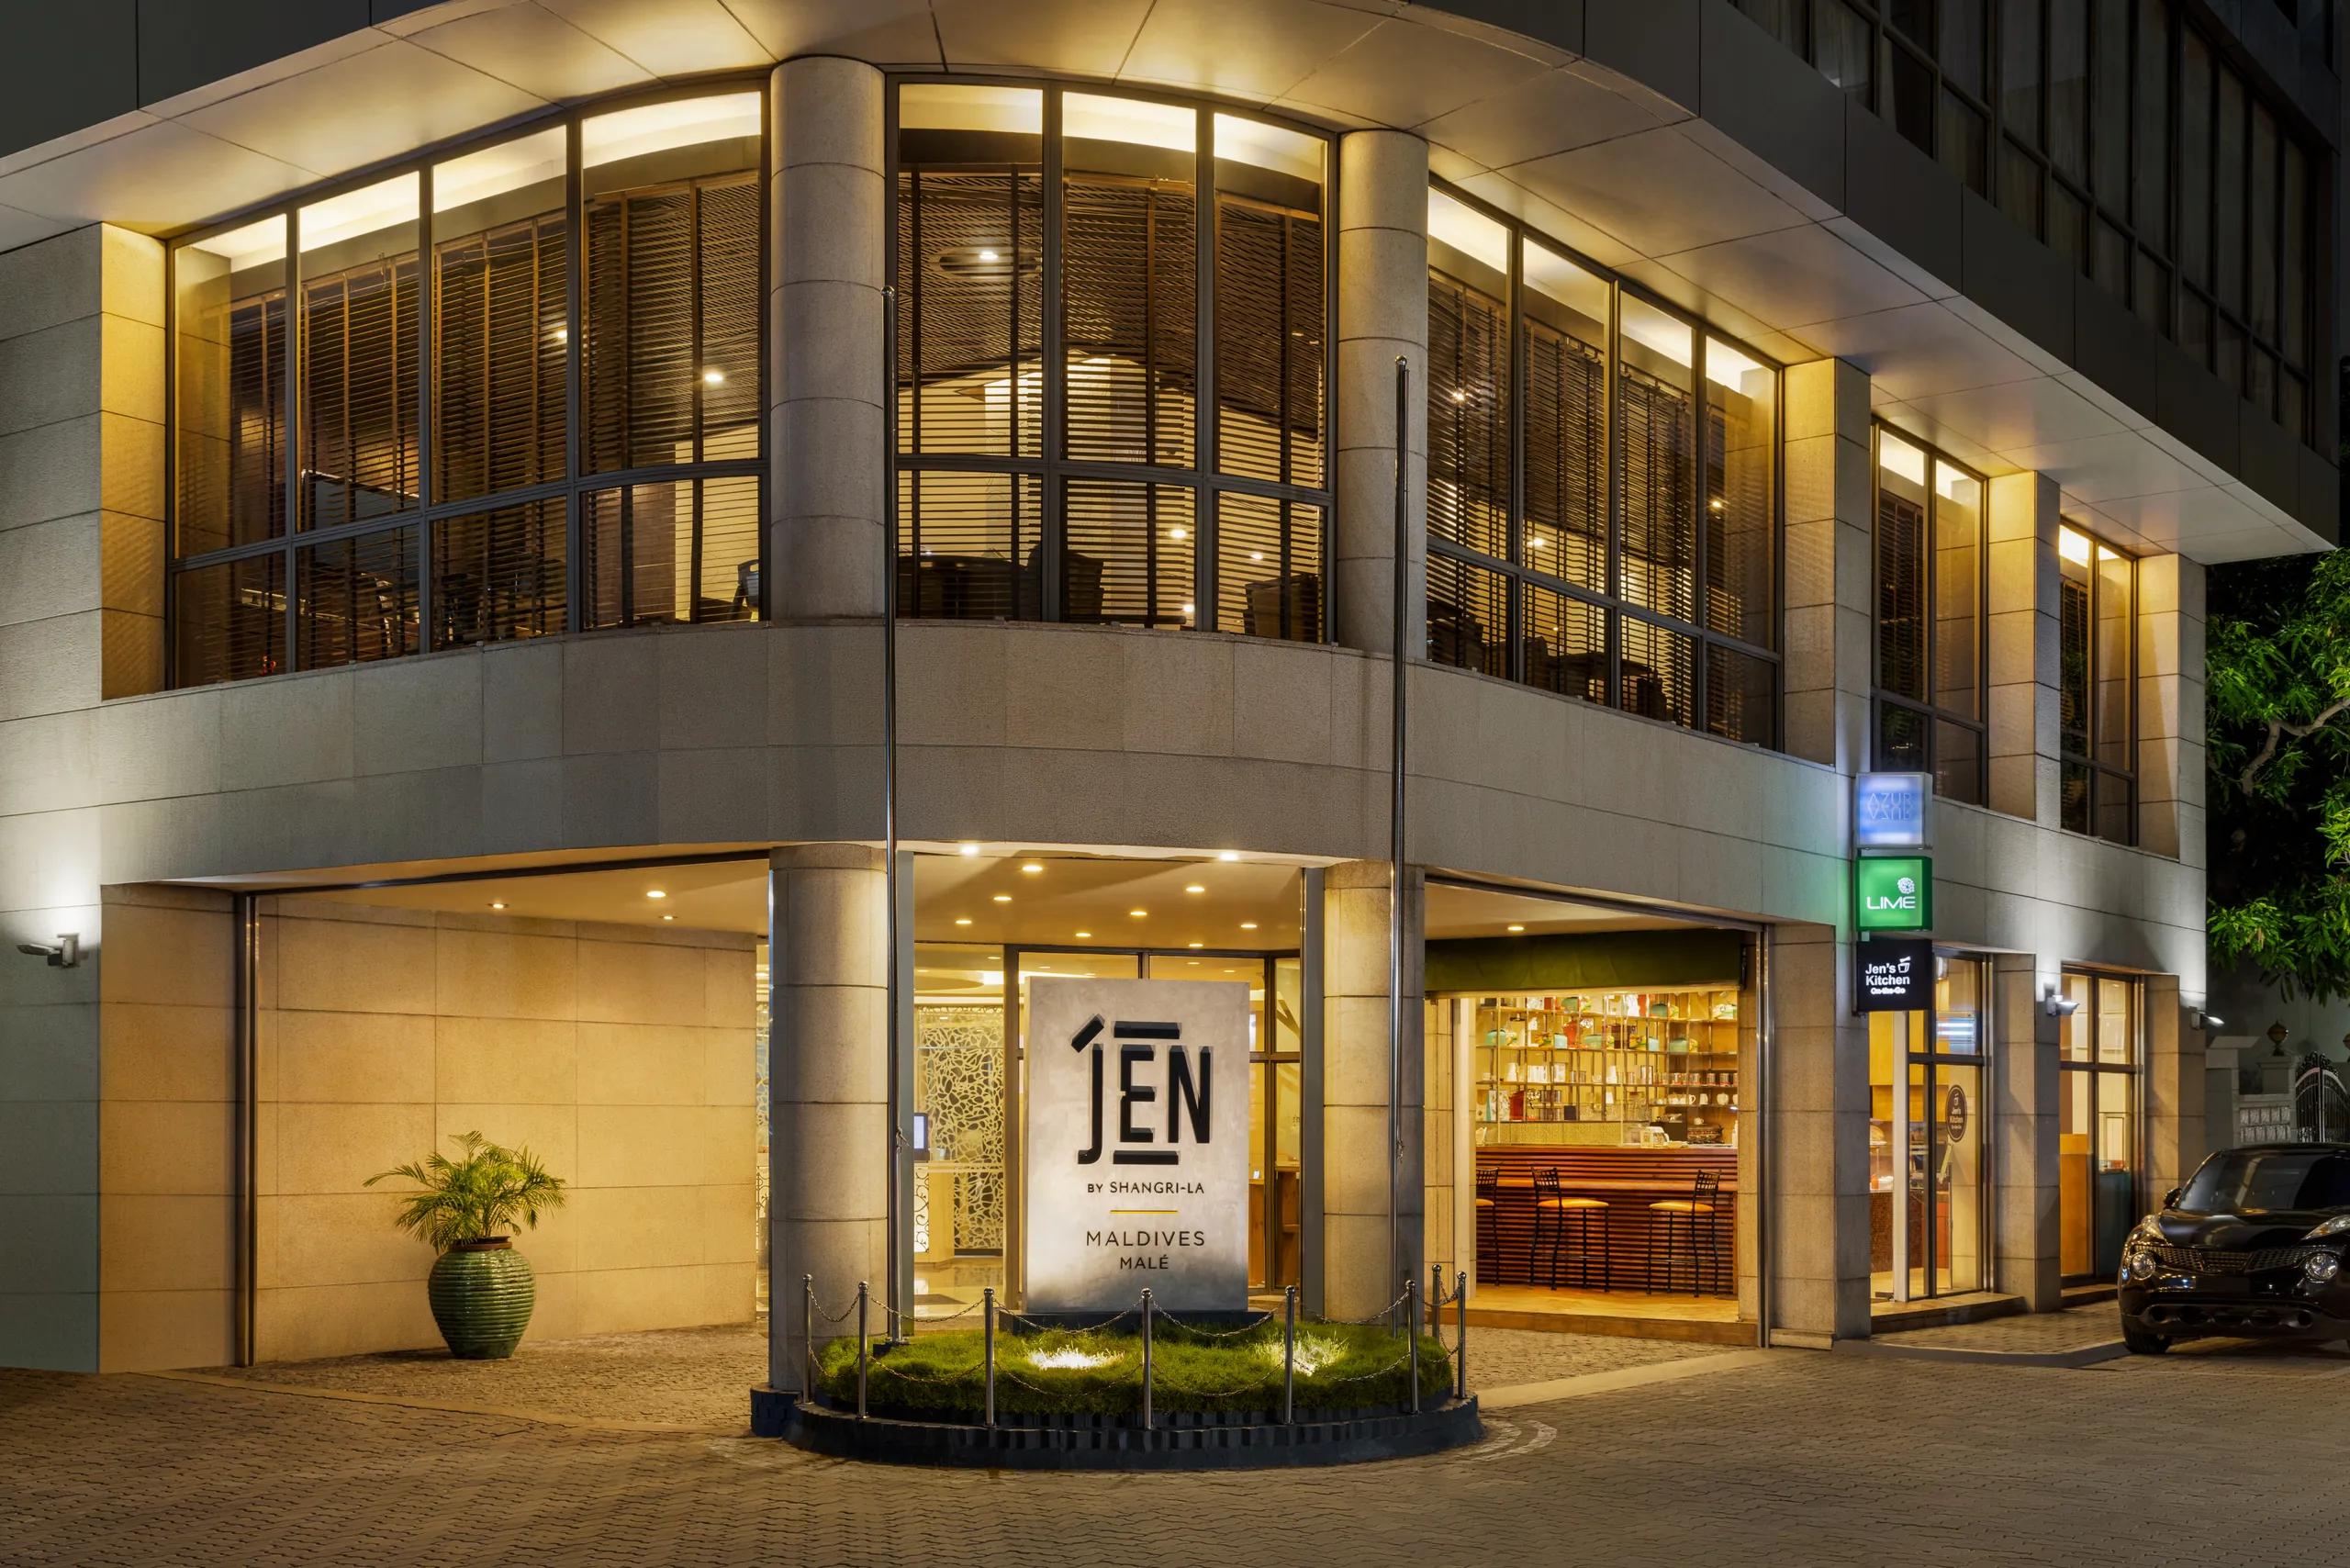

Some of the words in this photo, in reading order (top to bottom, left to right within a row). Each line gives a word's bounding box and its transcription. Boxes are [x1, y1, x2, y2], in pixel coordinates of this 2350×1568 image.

[1866, 896, 1916, 910] LIME
[1865, 962, 1897, 974] Jen's
[1865, 974, 1910, 986] Kitchen
[1070, 1014, 1212, 1165] JEN
[1087, 1182, 1103, 1193] BY
[1109, 1181, 1205, 1194] SHANGRI-LA
[1086, 1230, 1205, 1247] MALDIVES
[1120, 1254, 1169, 1270] MALÉ
